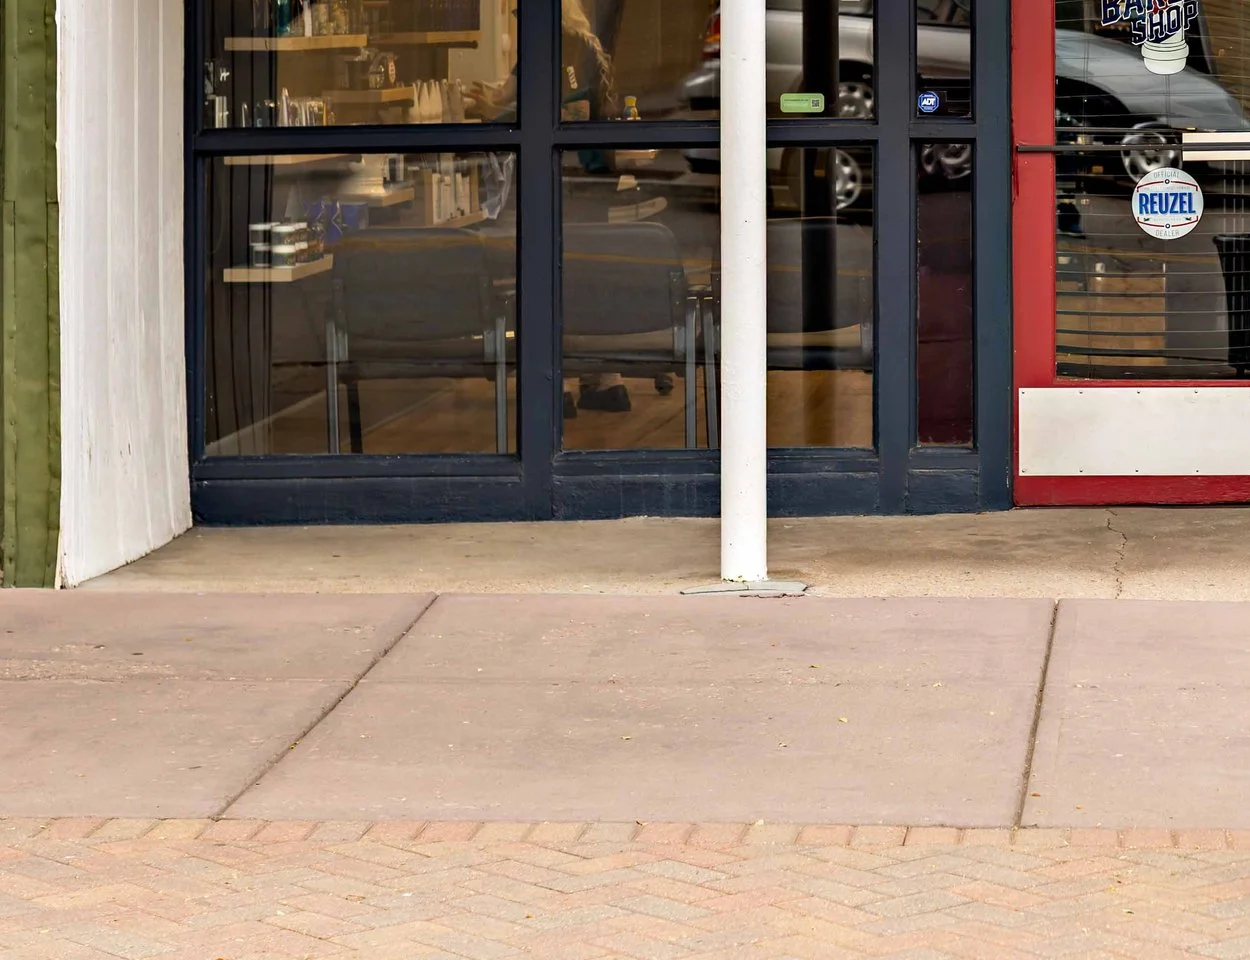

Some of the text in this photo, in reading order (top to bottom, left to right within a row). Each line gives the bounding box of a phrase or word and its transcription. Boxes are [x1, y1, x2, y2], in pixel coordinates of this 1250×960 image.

[1131, 0, 1199, 46] SHOP
[921, 98, 936, 106] ADT
[1153, 171, 1180, 179] OFFICIAL
[1138, 192, 1197, 215] REUZEL
[1155, 229, 1180, 237] DEALER
